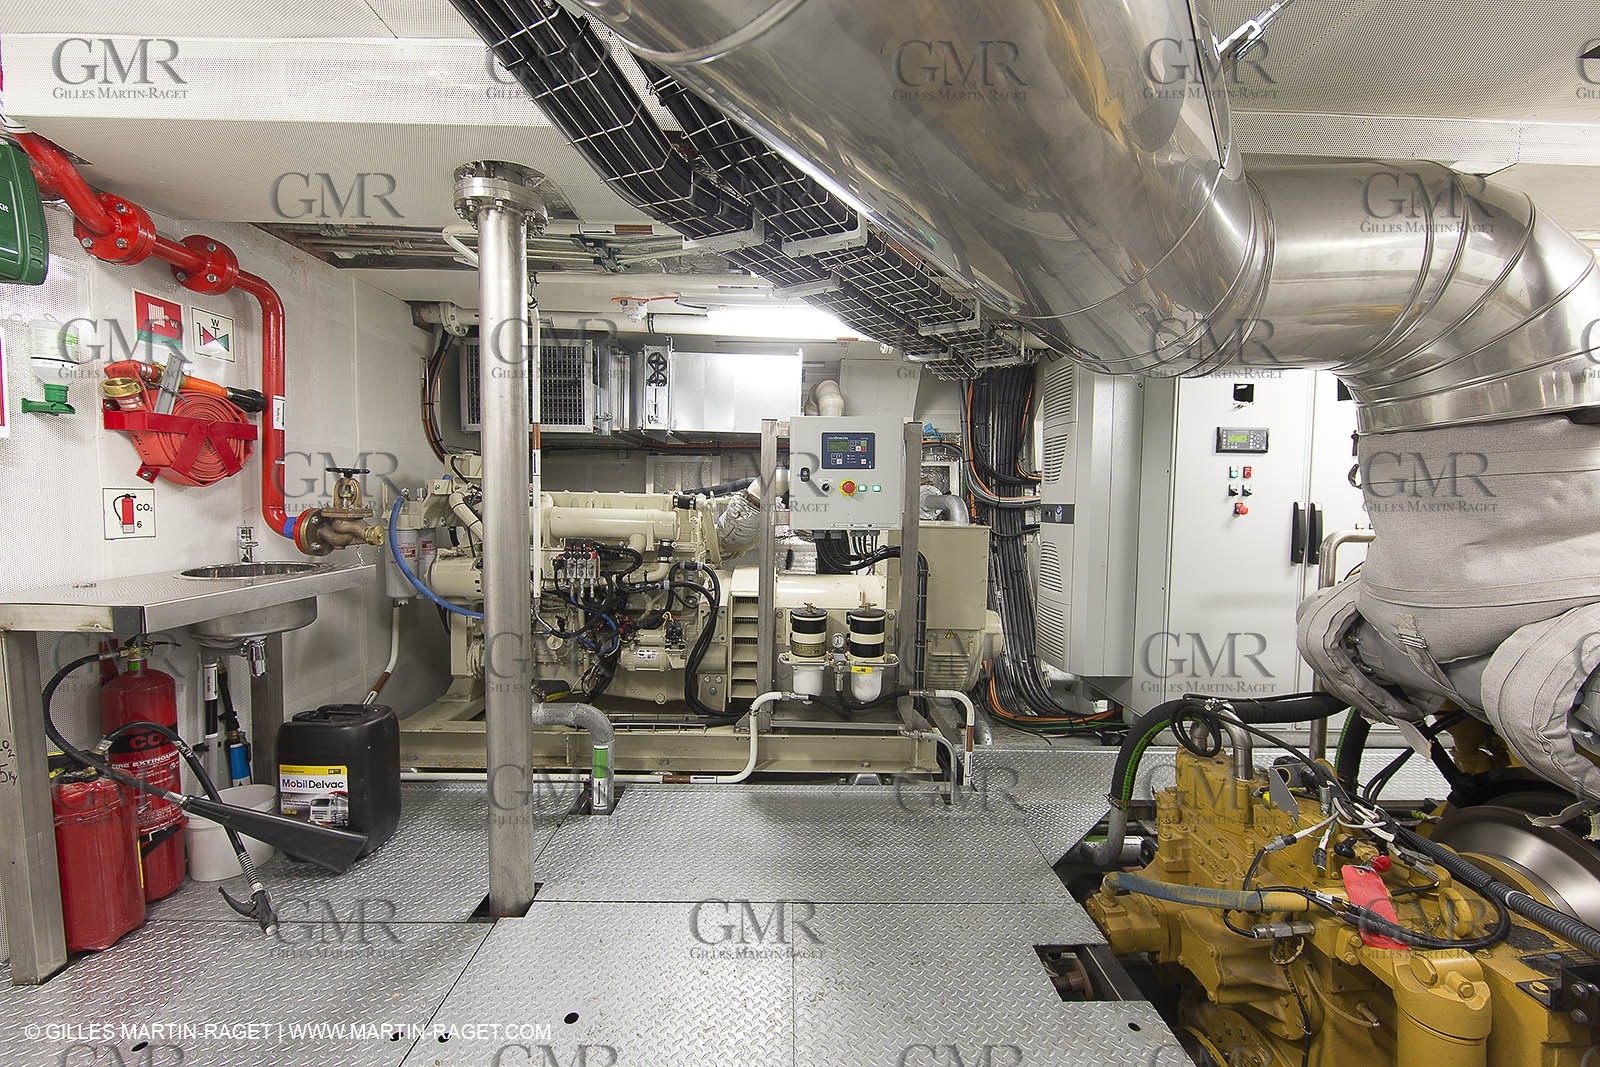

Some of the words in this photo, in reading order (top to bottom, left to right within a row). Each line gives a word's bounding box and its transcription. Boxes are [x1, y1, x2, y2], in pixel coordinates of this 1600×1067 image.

[210, 318, 220, 327] W
[136, 520, 143, 529] 6
[281, 779, 308, 789] Mobil
[308, 780, 345, 789] Delvac
